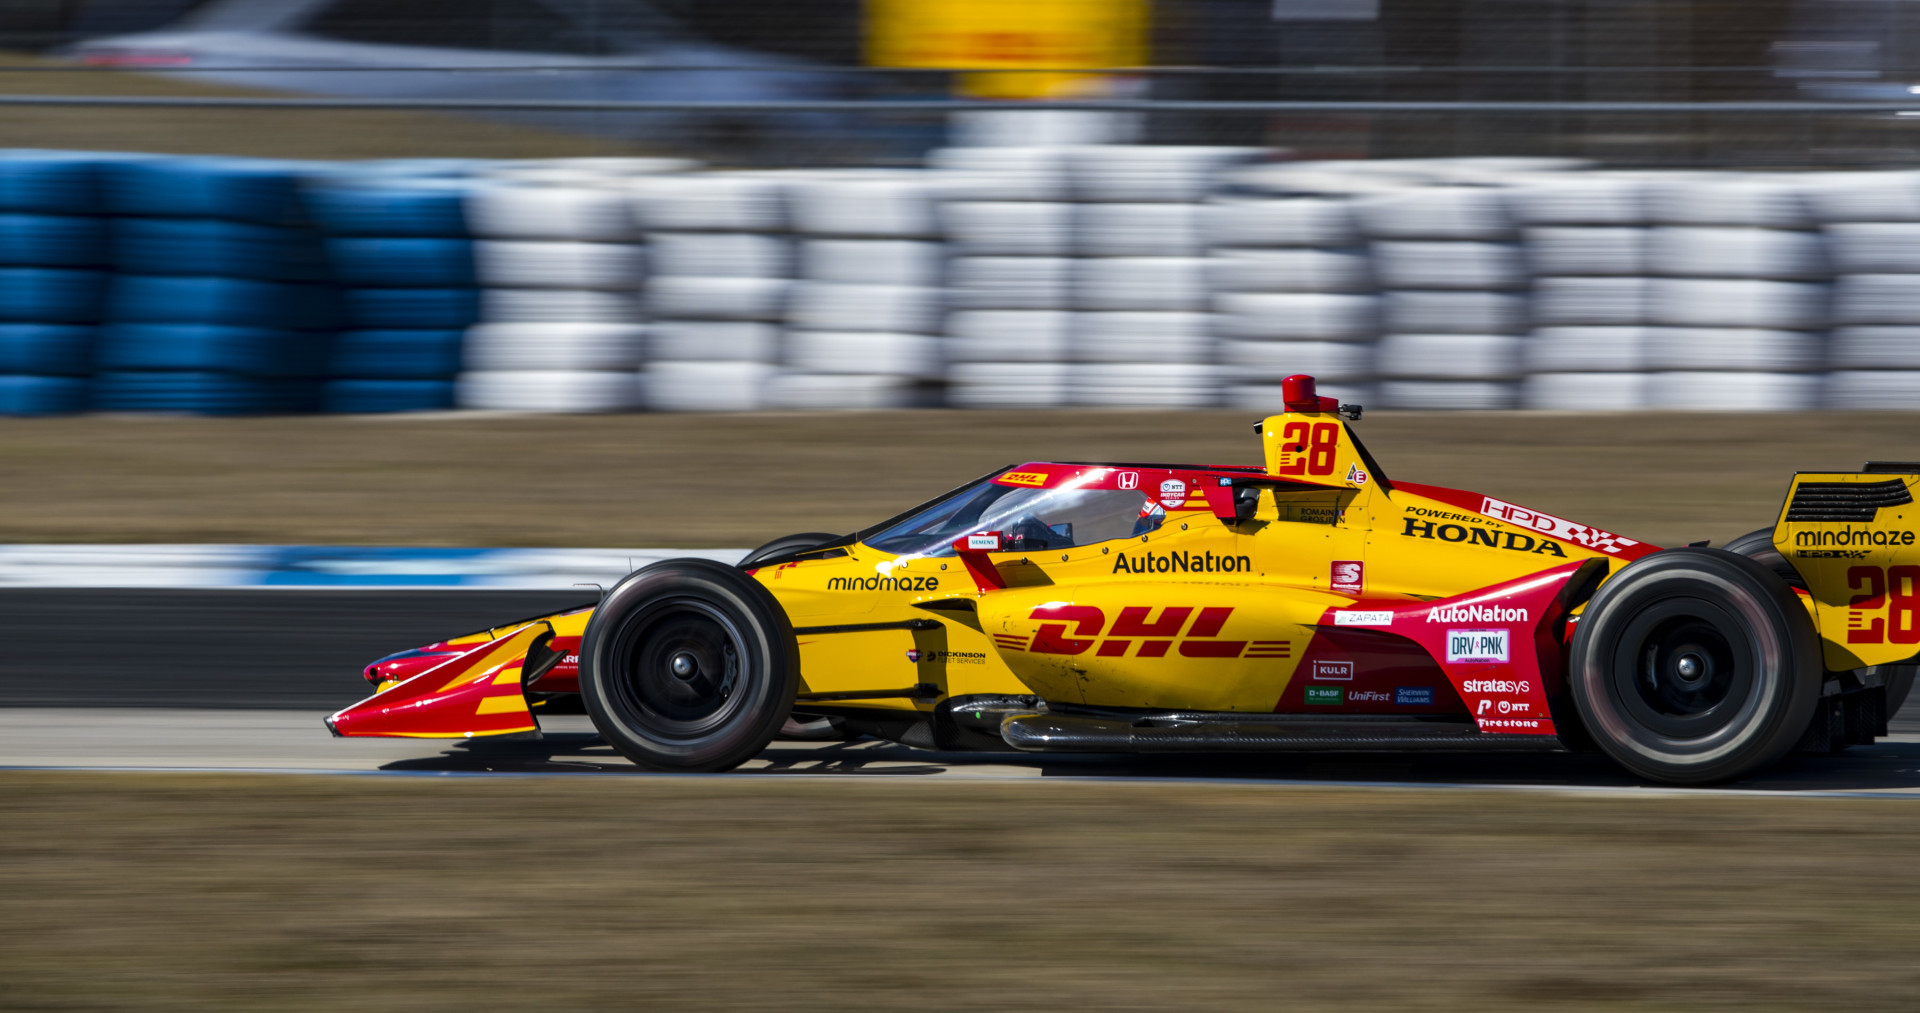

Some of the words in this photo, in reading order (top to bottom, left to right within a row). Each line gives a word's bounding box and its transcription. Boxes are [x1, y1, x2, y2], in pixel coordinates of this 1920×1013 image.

[1279, 421, 1339, 476] 28
[1005, 473, 1039, 483] DHL
[1300, 508, 1334, 516] ROMAIN
[1300, 515, 1346, 524] GROSJEN
[1405, 506, 1482, 524] POWERED
[1483, 499, 1557, 532] HPD
[1401, 517, 1568, 558] HONDA
[1796, 524, 1916, 546] mindmaze
[1112, 549, 1251, 574] AutoNation
[827, 571, 939, 592] mindmaze
[1847, 564, 1920, 645] 28
[1349, 613, 1390, 623] ZAPATA
[1426, 604, 1529, 623] AutoNation
[1028, 605, 1248, 659] DHL
[1452, 636, 1475, 655] DRV
[1480, 636, 1503, 655] PNK
[938, 650, 986, 659] DICKINSON
[1320, 666, 1348, 675] KULR
[1348, 690, 1391, 701] UniFirst
[1398, 688, 1430, 696] SHERWIN
[1463, 679, 1530, 695] stratasys
[1511, 703, 1530, 712] NTT
[1477, 718, 1539, 729] Firestone
